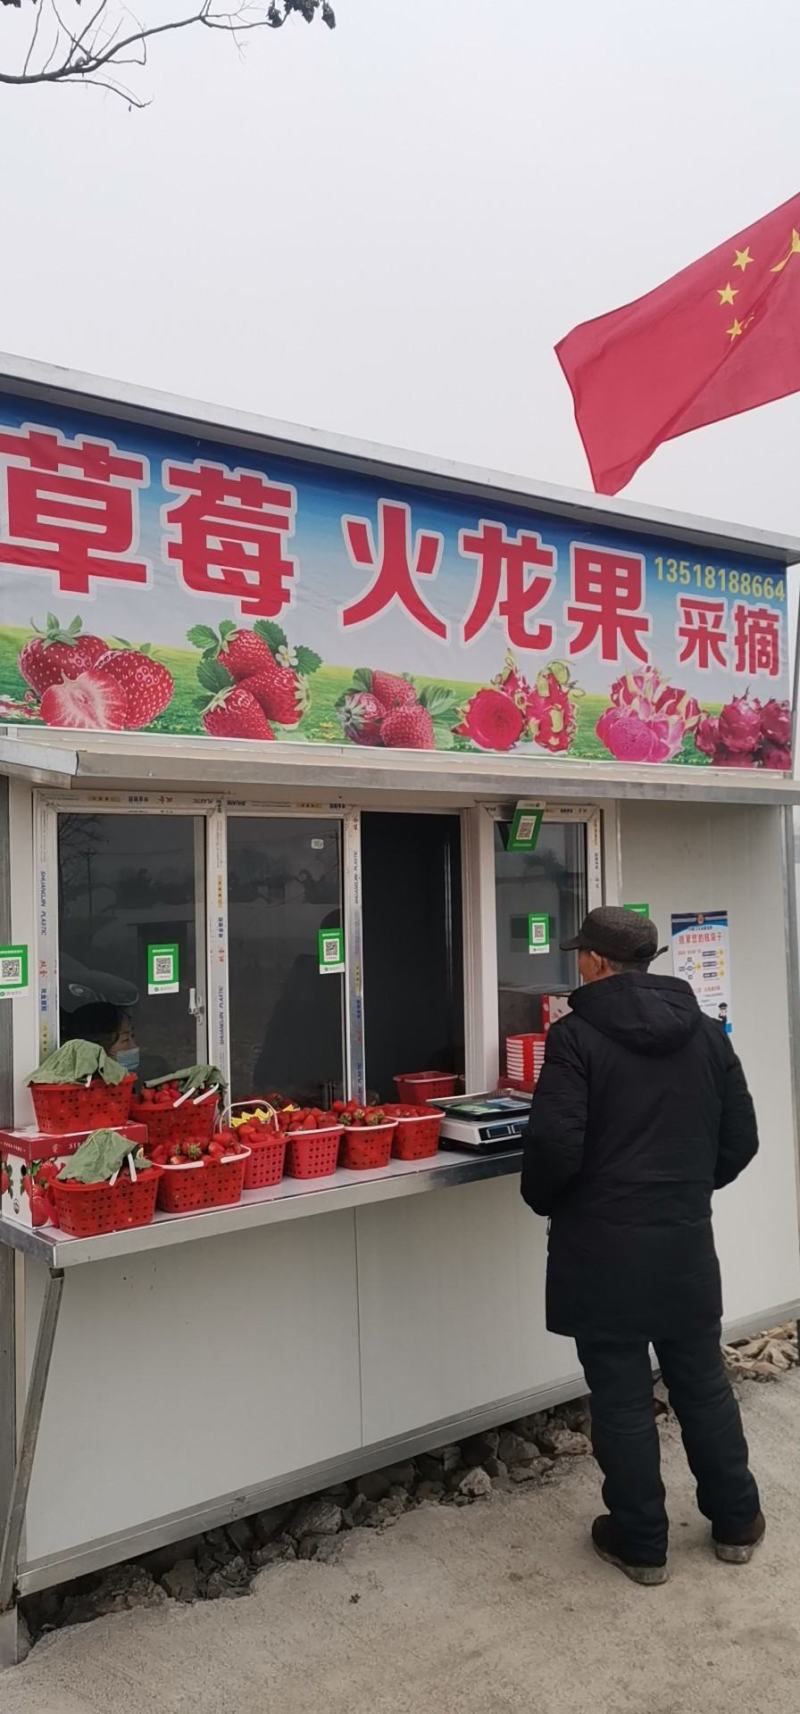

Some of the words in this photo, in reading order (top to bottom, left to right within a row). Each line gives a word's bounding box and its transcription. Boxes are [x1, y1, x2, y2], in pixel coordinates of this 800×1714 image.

[0, 430, 295, 617] 草莓
[343, 503, 650, 664] 火龙果
[678, 598, 780, 677] 采摘
[654, 557, 785, 601] 13518188664
